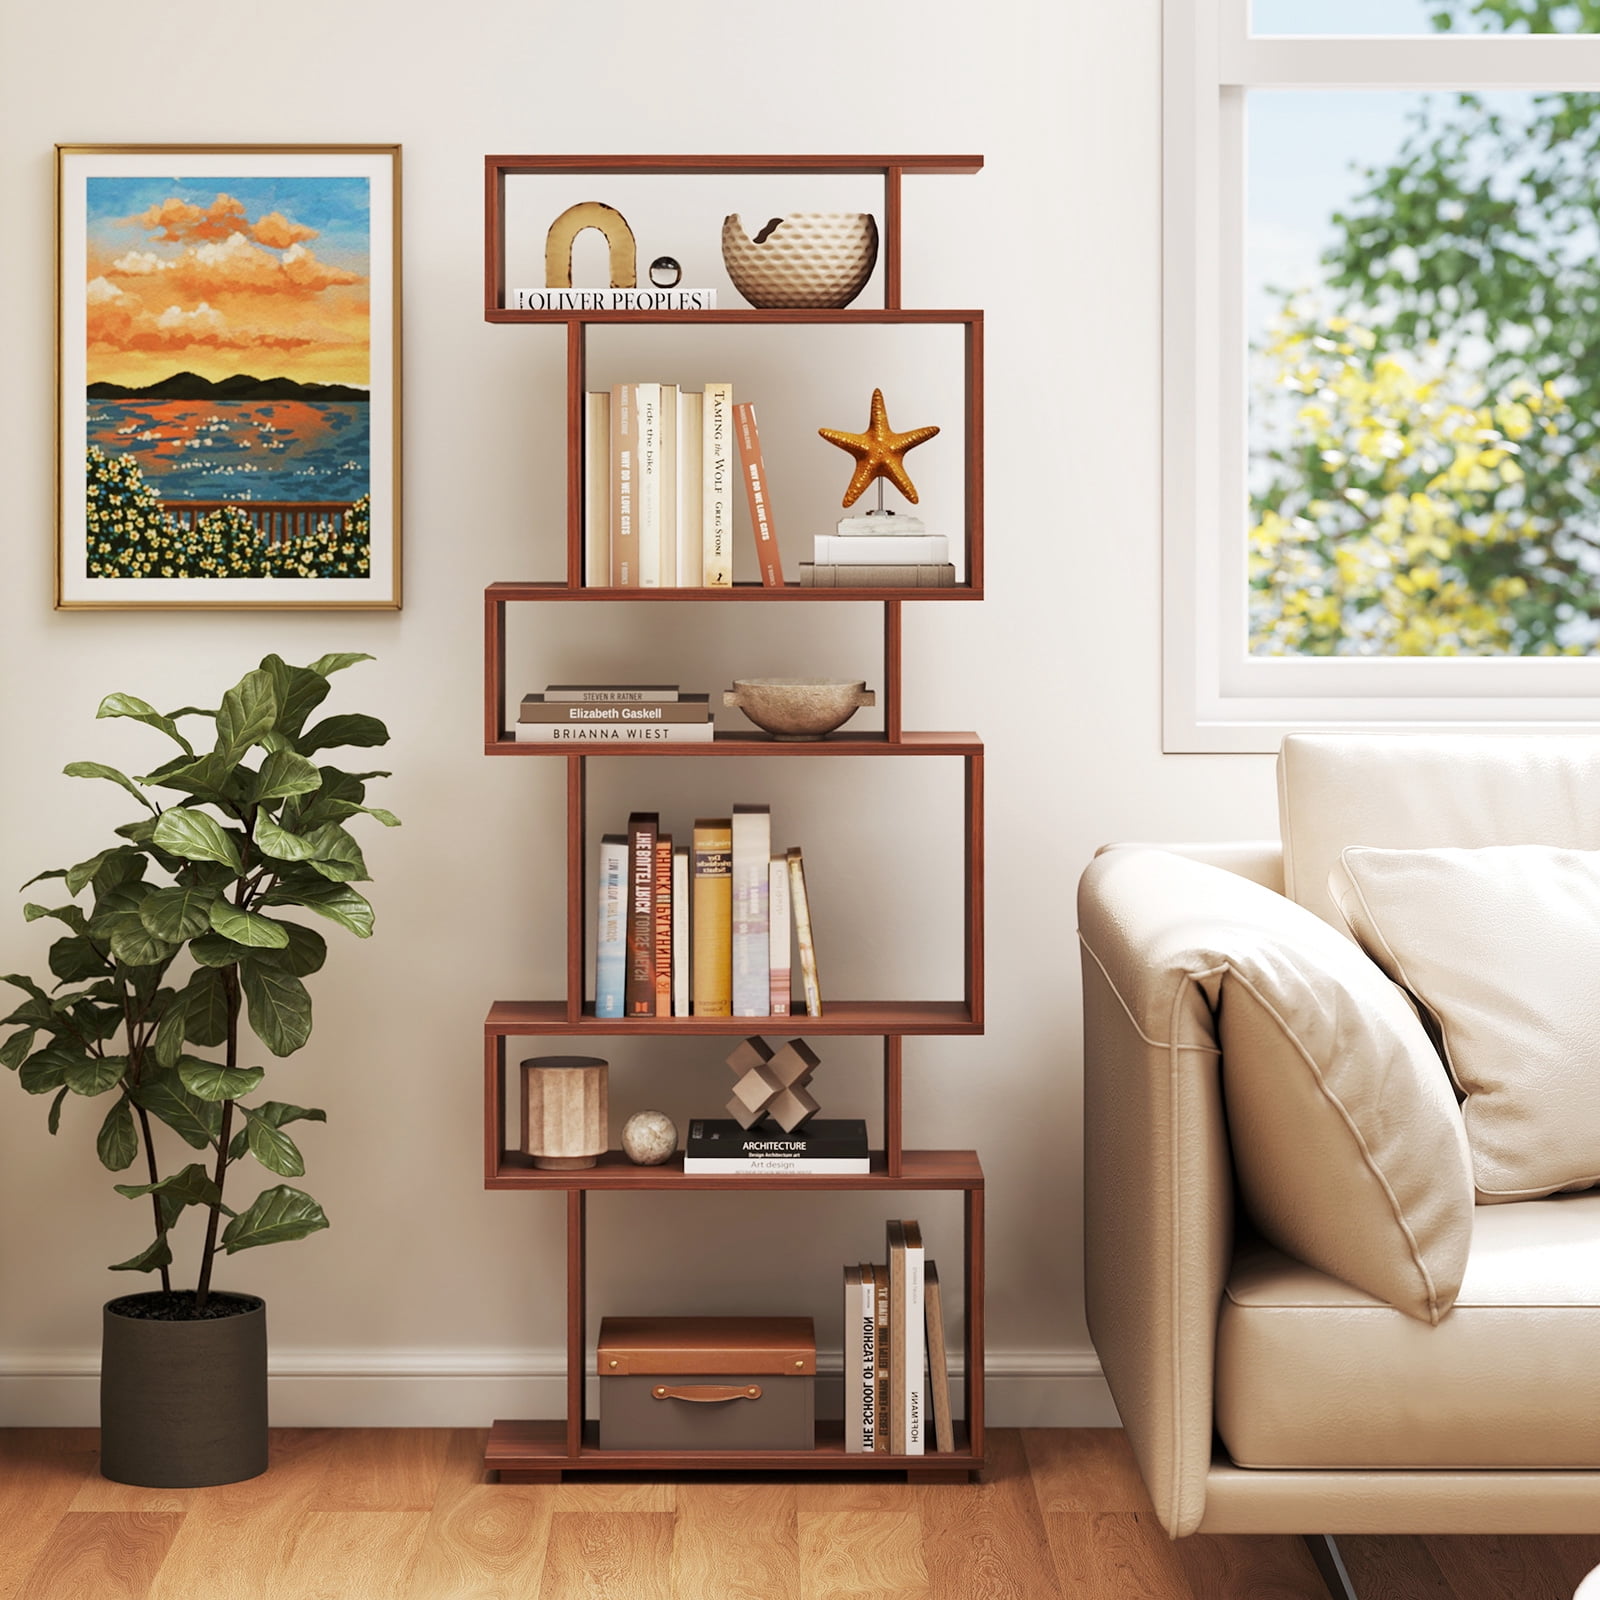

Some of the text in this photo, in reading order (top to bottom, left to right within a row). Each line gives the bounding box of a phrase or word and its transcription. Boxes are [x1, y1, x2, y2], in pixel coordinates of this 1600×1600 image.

[528, 292, 604, 310] OLIVER
[612, 292, 702, 310] PEOPLES
[714, 390, 725, 494] TAMING the WOLF
[714, 501, 723, 557] GREG STONE
[583, 692, 643, 701] STEVEN R RATNER
[569, 708, 662, 719] Elizabeth Gaskell
[553, 729, 670, 739] BRIANNA WIEST
[742, 1141, 807, 1151] ARCHITECTURE
[750, 1160, 795, 1170] Art design
